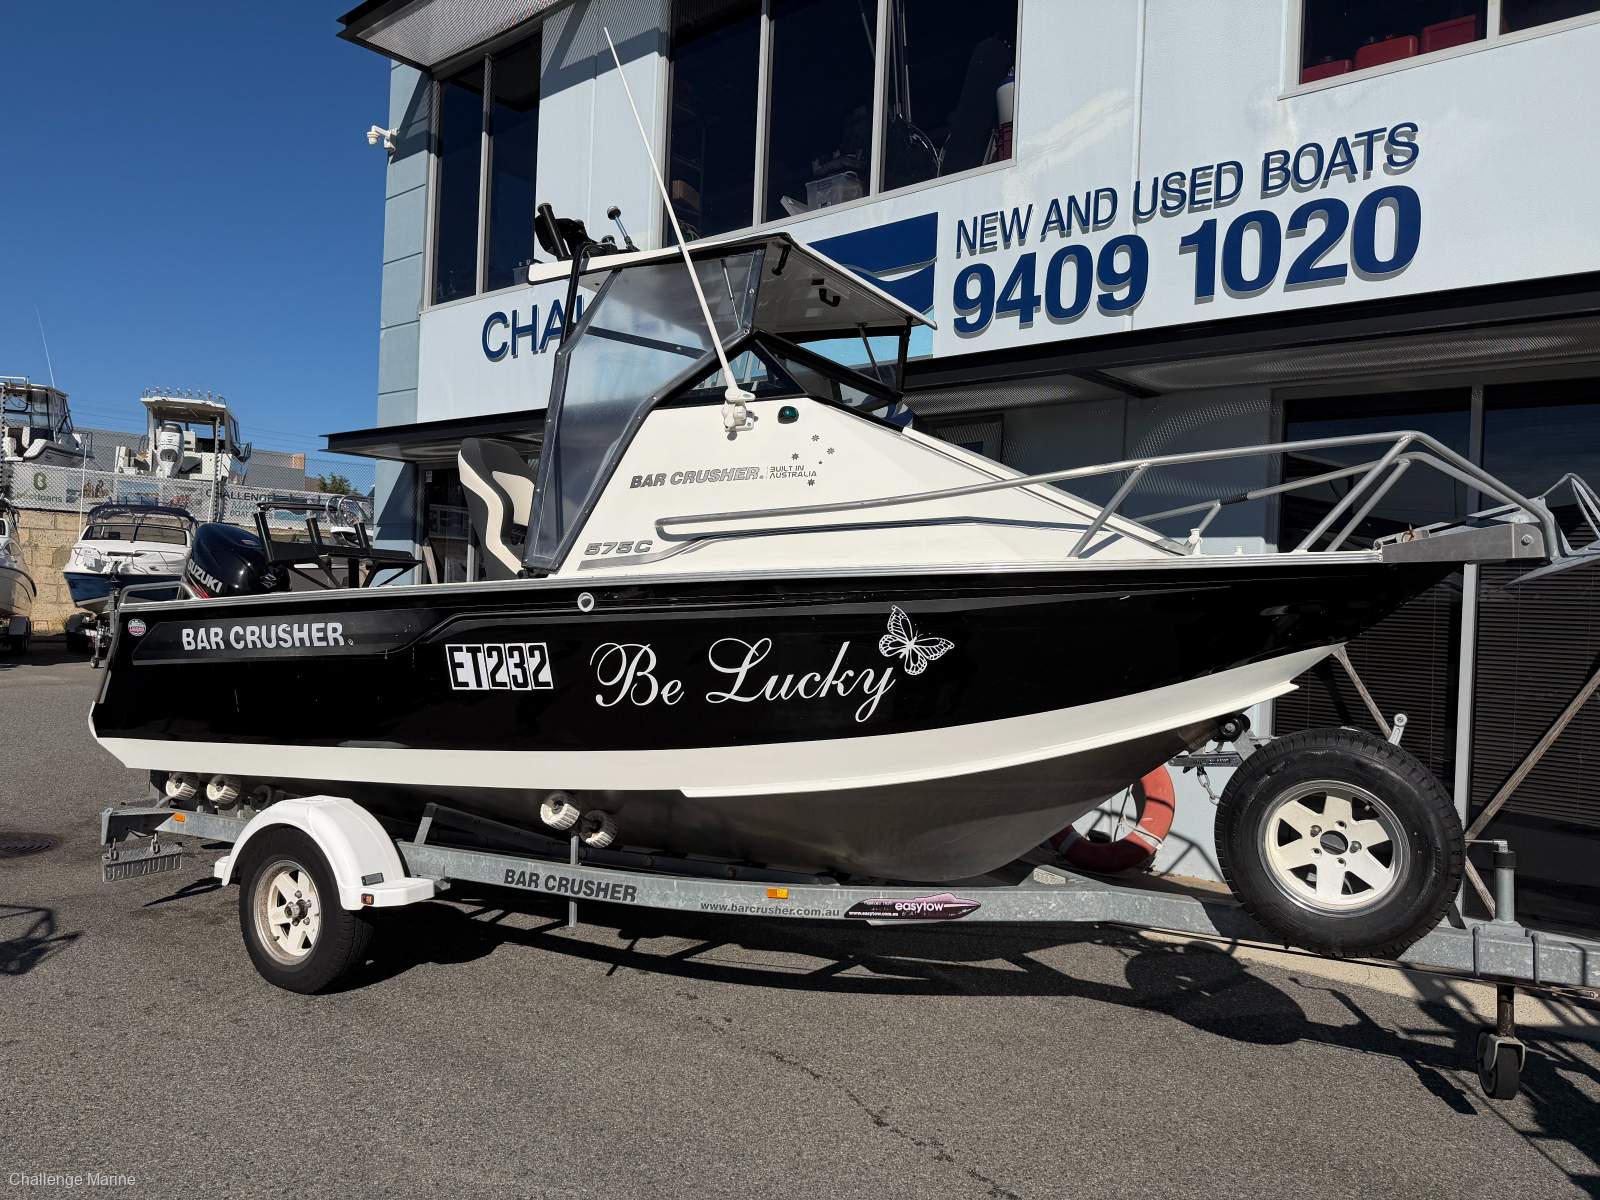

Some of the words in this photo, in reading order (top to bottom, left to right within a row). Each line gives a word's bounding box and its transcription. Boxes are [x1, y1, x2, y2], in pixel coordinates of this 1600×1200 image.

[956, 203, 1033, 259] NEW
[1040, 187, 1118, 242] AND
[1133, 160, 1244, 225] USED
[1260, 121, 1420, 200] BOATS
[951, 234, 1149, 336] 9409
[1179, 184, 1421, 305] 1020
[630, 472, 667, 488] BAR
[669, 466, 760, 485] CRUSHER
[769, 465, 793, 473] BUILT
[769, 470, 817, 479] AUSTRALIA
[583, 540, 653, 556] 575C
[187, 559, 223, 593] SUZUKI
[181, 627, 225, 651] BAR
[229, 622, 346, 650] CRUSHER
[444, 642, 554, 691] ET232
[589, 642, 684, 707] Be
[705, 637, 896, 723] Lucky
[503, 868, 540, 889] BAR
[544, 874, 638, 902] CRUSHER
[700, 902, 840, 917] www.barcrusher.com.au
[894, 901, 945, 913] easytow
